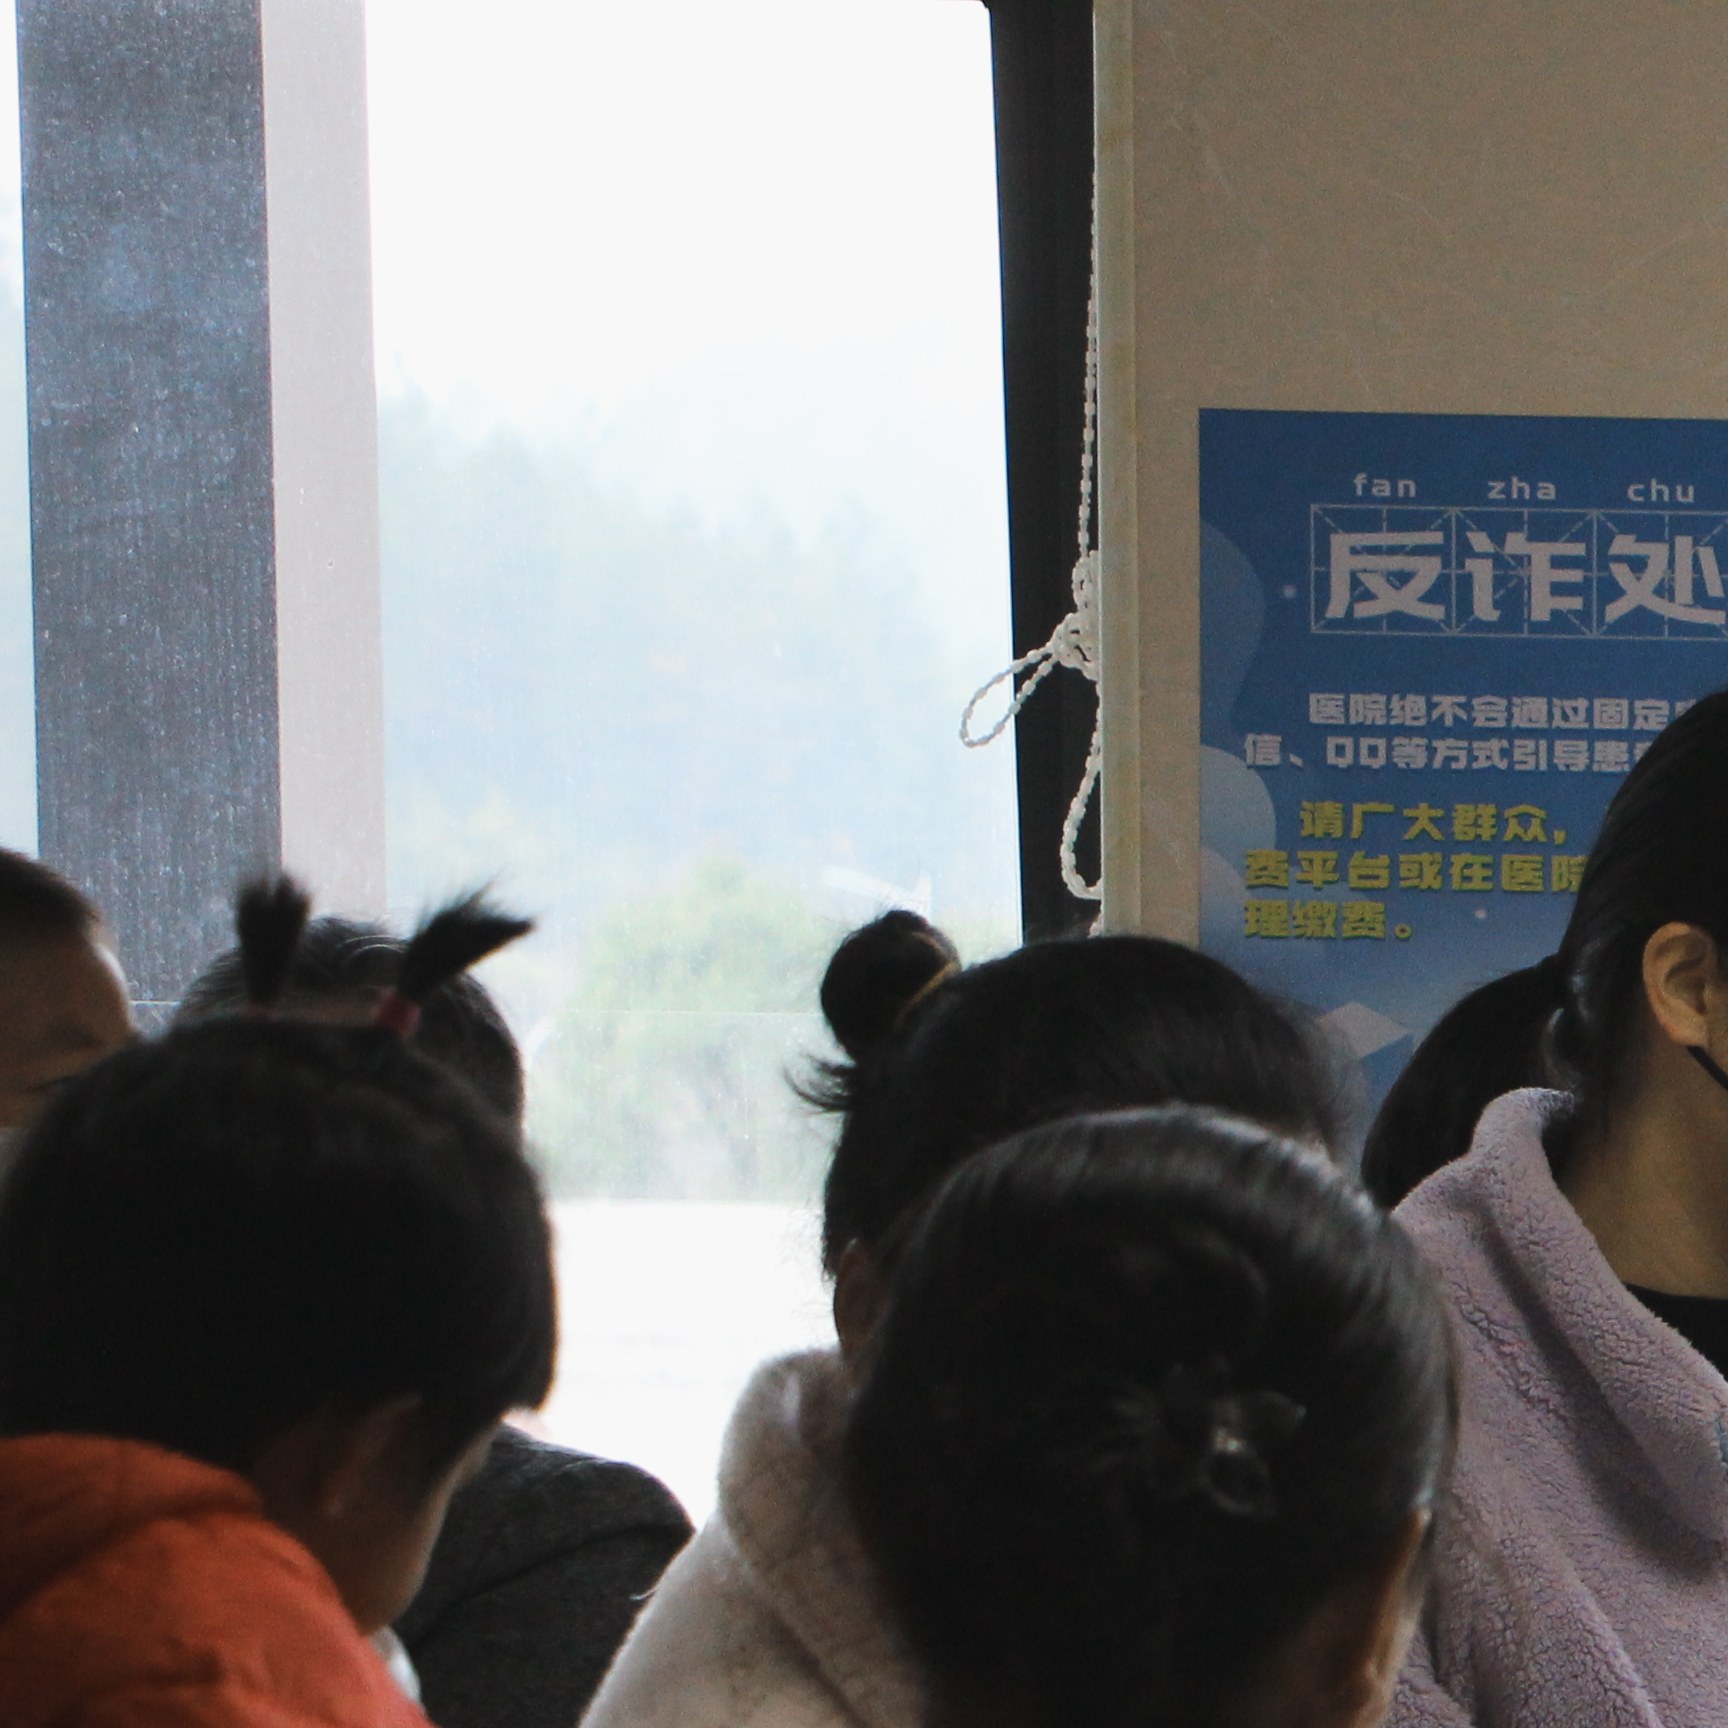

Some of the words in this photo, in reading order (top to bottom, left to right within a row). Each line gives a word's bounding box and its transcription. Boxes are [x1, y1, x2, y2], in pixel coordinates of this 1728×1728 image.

[1353, 472, 1418, 498] fan
[1487, 475, 1557, 500] zha
[1627, 478, 1695, 503] chu
[1308, 692, 1697, 731] 医院绝不会通过固定
